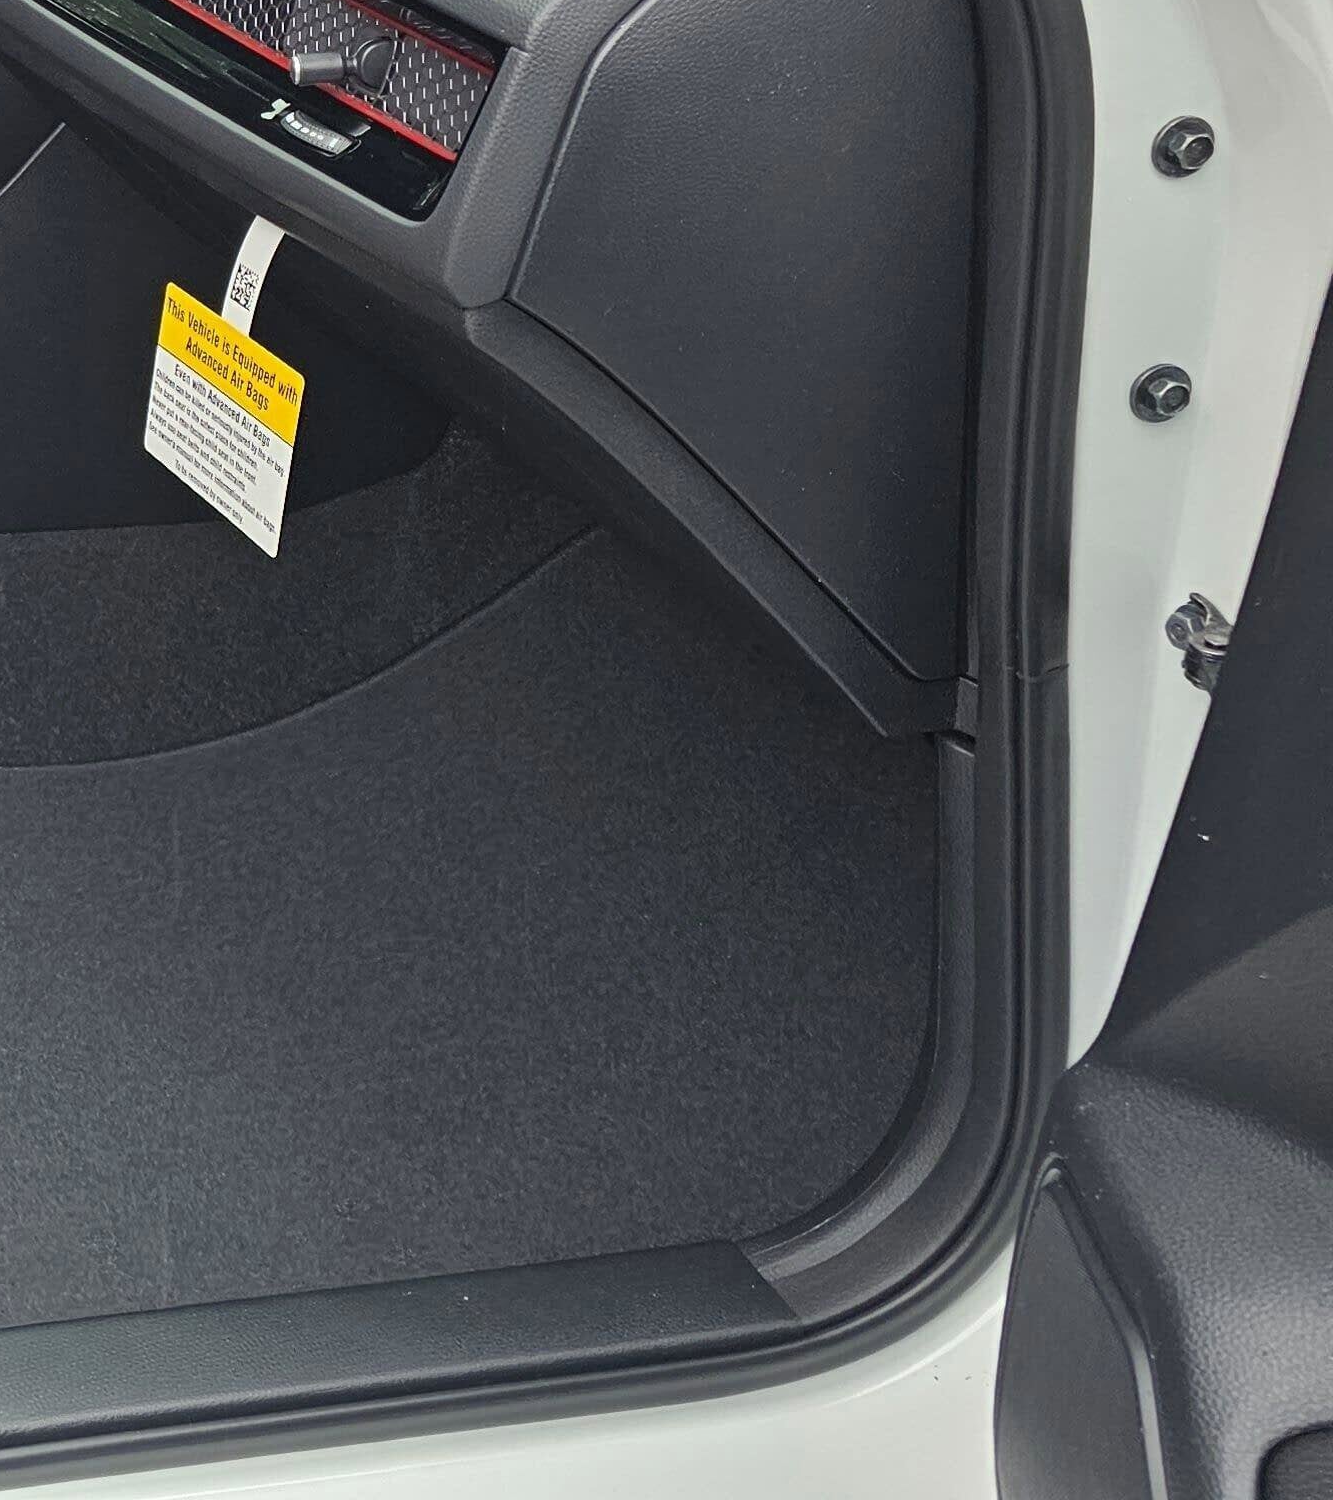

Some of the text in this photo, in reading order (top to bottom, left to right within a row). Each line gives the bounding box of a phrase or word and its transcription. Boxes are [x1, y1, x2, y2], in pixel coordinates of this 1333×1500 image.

[167, 296, 298, 406] This Vehicle is Equipped with
[185, 336, 270, 411] Advanced Air Bags
[174, 363, 271, 448] Even with Advanced Air Bags
